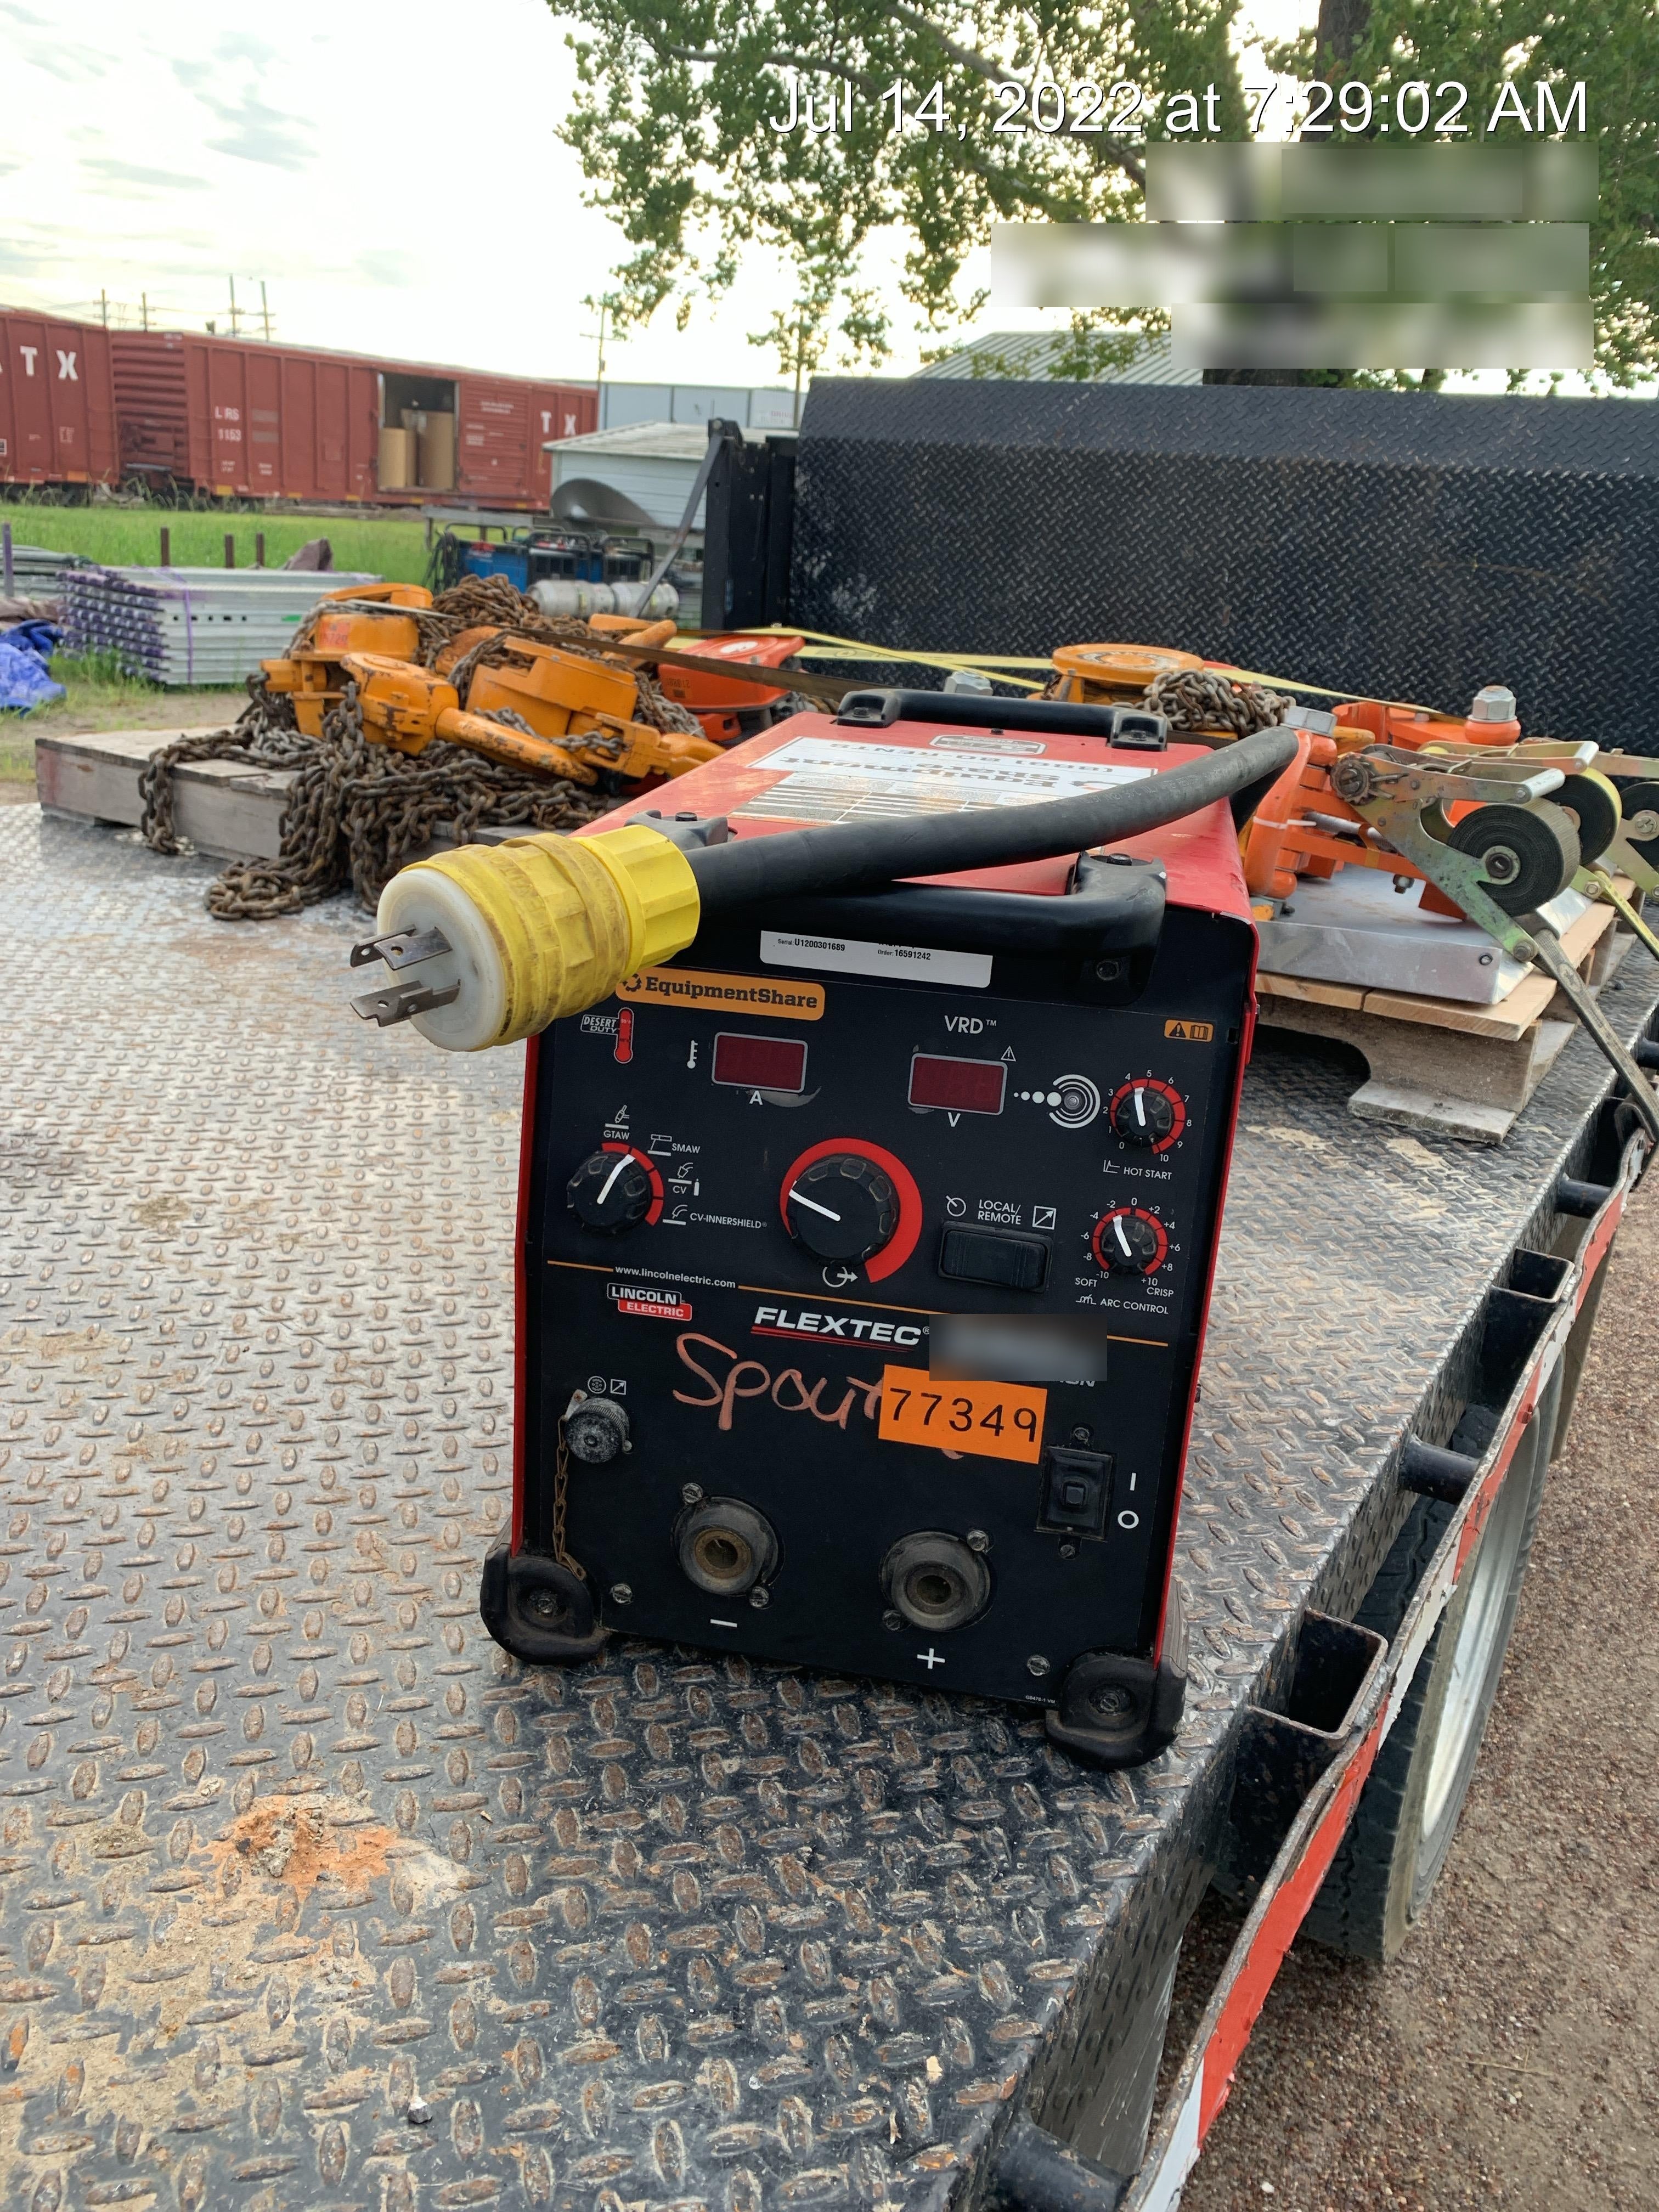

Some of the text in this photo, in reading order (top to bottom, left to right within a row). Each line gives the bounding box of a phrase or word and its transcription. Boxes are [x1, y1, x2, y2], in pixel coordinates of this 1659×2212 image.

[779, 757, 1054, 788] Equipment
[894, 949, 931, 960] 16591242
[645, 977, 818, 1010] EquipmentShare
[583, 1017, 617, 1028] DESERT
[749, 1091, 763, 1105] A
[947, 1112, 961, 1127] V
[603, 1129, 630, 1139] GTAW
[672, 1143, 701, 1154] SMAW
[1124, 1167, 1172, 1180] HOT START
[673, 1185, 686, 1194] CV
[979, 1199, 1021, 1215] LOCAL/
[1107, 1200, 1116, 1208] -2
[1132, 1198, 1137, 1206] 0
[1149, 1205, 1160, 1215] +2
[978, 1210, 1022, 1226] REMOTE
[1164, 1221, 1175, 1229] +4
[1169, 1243, 1180, 1252] +6
[1161, 1263, 1173, 1271] +8
[615, 1266, 736, 1289] www.lincolnelectric.com
[1096, 1271, 1109, 1279] -10
[1075, 1277, 1098, 1288] SOFT
[1141, 1277, 1158, 1286] +10
[612, 1286, 676, 1305] LINCOLN
[1147, 1286, 1174, 1297] CRISP
[627, 1302, 684, 1317] ELECTRIC
[1101, 1299, 1169, 1314] ARC CONTROL
[889, 1387, 1037, 1443] 77349
